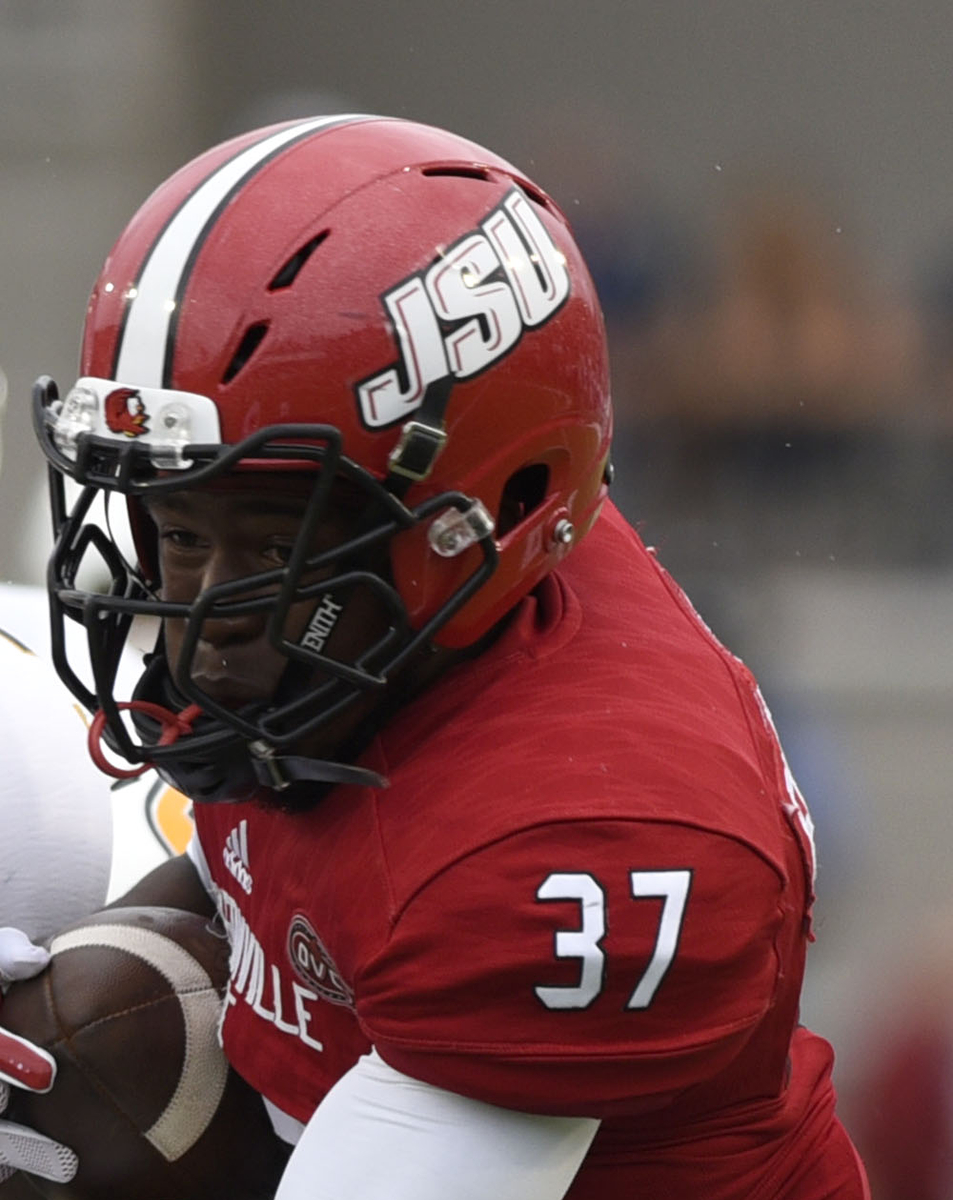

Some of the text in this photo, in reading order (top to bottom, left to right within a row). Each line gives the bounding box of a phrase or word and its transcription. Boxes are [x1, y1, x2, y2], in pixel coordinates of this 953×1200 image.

[354, 188, 572, 430] JSU
[300, 595, 344, 652] ENITH
[534, 868, 693, 1012] 37
